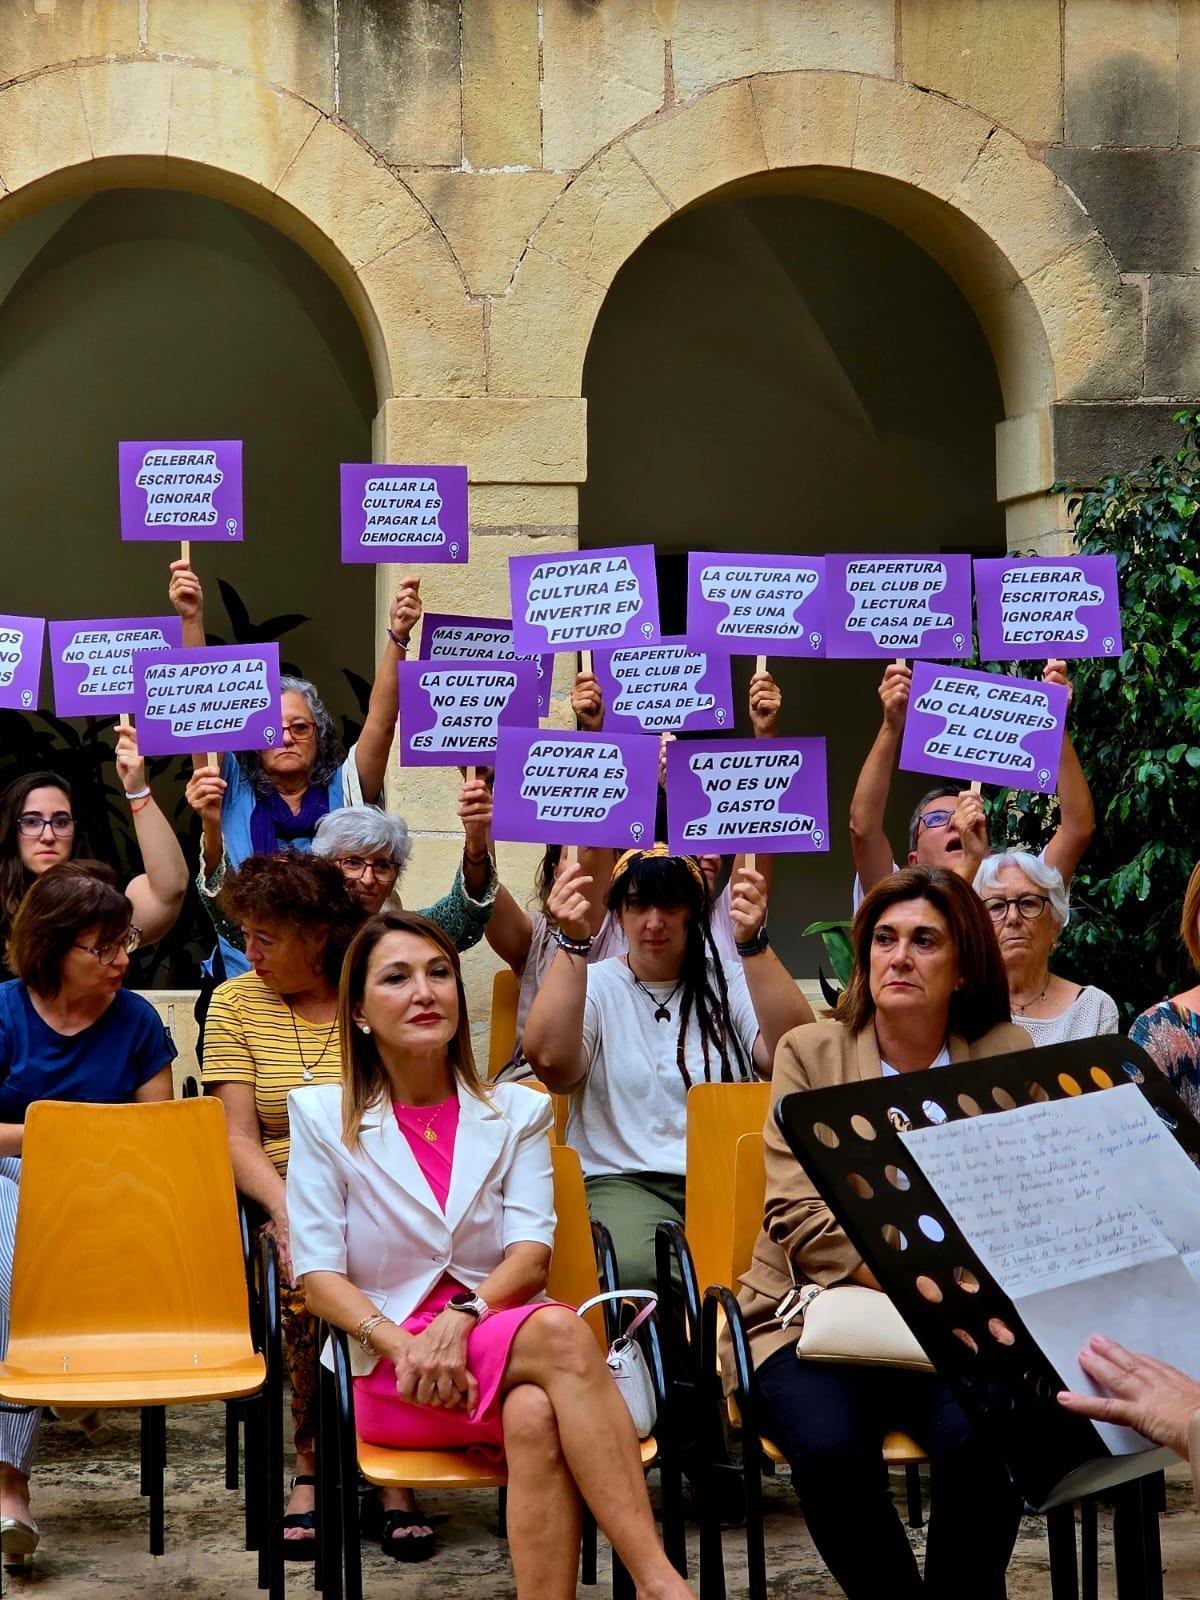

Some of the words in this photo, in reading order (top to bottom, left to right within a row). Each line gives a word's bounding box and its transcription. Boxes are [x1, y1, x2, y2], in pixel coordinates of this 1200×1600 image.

[145, 455, 214, 466] CELEBRAR
[138, 473, 222, 485] ESCRITORAS
[369, 482, 417, 491] CALLAR
[420, 482, 435, 491] LA
[150, 493, 211, 504] IGNORAR
[363, 498, 423, 509] CULTURA
[424, 498, 441, 509] ES
[147, 512, 216, 523] LECTORAS
[368, 516, 418, 525] APAGAR
[421, 516, 436, 525] LA
[360, 531, 444, 543] DEMOCRACIA
[533, 562, 601, 580] APOYAR
[606, 559, 627, 572] LA
[847, 563, 943, 574] REAPERTURA
[703, 571, 720, 580] LA
[726, 572, 790, 582] CULTURA
[796, 574, 816, 583] NO
[1001, 572, 1082, 583] CELEBRAR
[529, 582, 608, 601] CULTURA
[615, 579, 636, 592] ES
[850, 582, 876, 591] DEL
[881, 581, 919, 591] CLUB
[923, 581, 942, 591] DE
[708, 589, 726, 598] ES
[731, 589, 751, 598] UN
[756, 590, 803, 599] GASTO
[1002, 591, 1101, 603] ESCRITORAS,
[861, 599, 926, 609] LECTURA
[530, 603, 611, 622] INVERTIR
[616, 600, 640, 613] EN
[733, 606, 752, 616] ES
[756, 607, 784, 617] UNA
[1003, 611, 1073, 622] IGNORAR
[848, 617, 867, 627] DE
[871, 617, 907, 627] CASA
[913, 617, 932, 626] DE
[935, 617, 952, 626] LA
[551, 623, 621, 640] FUTURO
[720, 624, 799, 634] INVERSIÓN
[0, 632, 21, 644] OS
[75, 634, 110, 644] LEER,
[116, 631, 161, 642] CREAR.
[433, 629, 462, 641] MÁS
[464, 632, 510, 643] APOYO
[879, 635, 918, 644] DONA
[1004, 630, 1084, 641] LECTORAS
[66, 651, 84, 661] NO
[88, 647, 170, 660] CLAUS
[433, 646, 493, 659] CULTURA
[93, 666, 107, 675] EL
[146, 668, 176, 679] MÁS
[180, 665, 227, 677] APOYO
[231, 663, 240, 673] A
[246, 662, 263, 672] LA
[616, 668, 640, 678] DEL
[645, 666, 680, 676] CLUB
[684, 665, 702, 674] DE
[422, 675, 440, 686] LA
[446, 676, 514, 687] CULTURA
[80, 683, 98, 693] DE
[148, 683, 212, 697] CULTURA
[218, 680, 263, 692] LOCAL
[627, 682, 687, 694] LECTURA
[934, 680, 980, 699] LEER,
[987, 689, 1046, 707] CREAR.
[146, 705, 166, 715] DE
[169, 703, 196, 714] LAS
[200, 698, 268, 712] MUJERES
[433, 696, 455, 707] NO
[459, 696, 479, 707] ES
[483, 696, 506, 707] UN
[615, 701, 633, 711] DE
[637, 699, 670, 710] CASA
[675, 698, 694, 707] DE
[697, 697, 712, 706] LA
[917, 698, 943, 711] NO
[947, 701, 1054, 730] CLAUSUREIS
[174, 721, 193, 732] DE
[196, 718, 243, 730] ELCHE
[442, 716, 493, 727] GASTO
[644, 715, 681, 726] DONA
[947, 724, 966, 736] EL
[973, 728, 1018, 744] CLUB
[413, 736, 433, 747] ES
[441, 736, 498, 748] INVERS
[530, 746, 594, 758] APOYAR
[598, 748, 618, 759] LA
[927, 742, 951, 755] DE
[954, 746, 1032, 768] LECTURA
[692, 758, 714, 770] LA
[720, 754, 800, 769] CULTURA
[525, 766, 598, 778] CULTURA
[603, 768, 624, 779] ES
[706, 779, 731, 791] NO
[736, 778, 758, 790] ES
[764, 777, 790, 789] UN
[523, 785, 599, 798] INVERTIR
[602, 788, 626, 799] EN
[540, 806, 606, 818] FUTURO
[717, 799, 775, 813] GASTO
[685, 824, 708, 836] ES
[717, 817, 814, 835] INVERSIÓN
